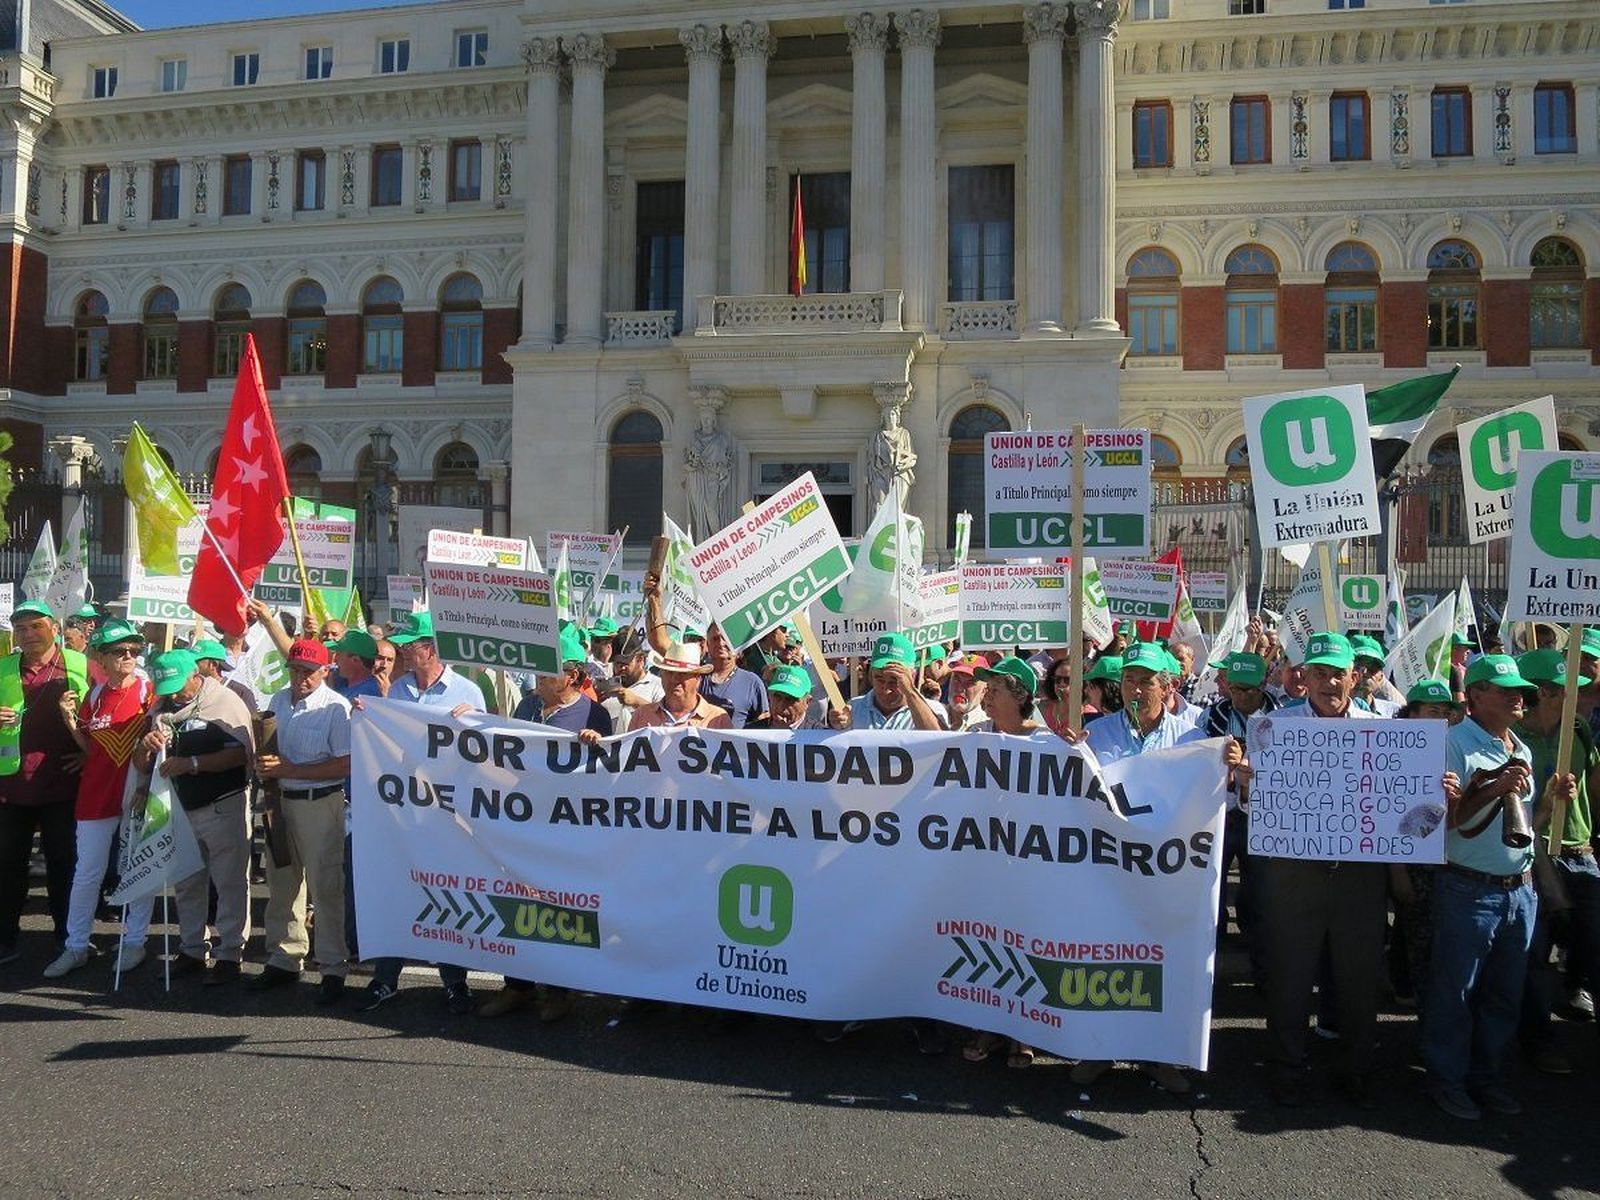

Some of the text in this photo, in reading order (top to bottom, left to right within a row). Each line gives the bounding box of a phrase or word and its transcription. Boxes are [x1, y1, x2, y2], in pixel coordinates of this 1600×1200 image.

[991, 434, 1144, 449] UNION DE CAPESINOS
[991, 453, 1059, 472] Castilla y León
[1105, 452, 1139, 465] UCCL
[995, 490, 1001, 499] a
[1002, 485, 1029, 500] Título
[1082, 488, 1100, 498] omo
[1101, 484, 1138, 501] siempre
[1273, 498, 1299, 517] La
[1475, 501, 1495, 517] La
[306, 523, 352, 533] CAMPESINOS
[691, 481, 814, 568] UNION DE CAMPESINOS
[1274, 514, 1369, 541] Extremadura
[432, 531, 524, 552] UNION DE CAMPESINOS
[580, 535, 613, 543] CAMPESIN
[699, 541, 758, 585] Castilla y León
[717, 526, 827, 608] a Título Principal, como siempre
[963, 566, 1065, 577] UNION DE CAMPESINOS
[1103, 561, 1124, 570] UNION
[1134, 563, 1175, 574] CAMPESINOS
[278, 567, 333, 585] UCCL
[430, 568, 464, 581] UNION
[466, 571, 481, 582] DE
[483, 573, 551, 591] CAMPESINOS
[928, 575, 960, 588] CAMPESIN
[963, 579, 987, 590] Castilla
[987, 582, 992, 592] y
[1529, 567, 1600, 590] La Un
[260, 586, 292, 600] UCCL
[432, 582, 486, 600] Castilla y León
[745, 567, 829, 631] UCCL
[146, 600, 195, 619] UCC
[1110, 600, 1157, 616] UCCL
[1196, 599, 1220, 609] UCCL
[438, 613, 443, 621] a
[521, 619, 549, 635] siempre
[822, 620, 839, 635] La
[980, 622, 1049, 643] UCCL
[457, 637, 537, 668] UCCL
[821, 637, 877, 654] Extremad
[427, 724, 1153, 819] POR UNA SANIDAD ANIMAL
[1260, 750, 1402, 772] MATADEROS
[1255, 770, 1434, 795] FAUNA SALVAJE
[377, 773, 1215, 876] QUE NO ARRUINE A LOS GANADEROS
[1251, 811, 1376, 835] POLITICOS
[1249, 834, 1415, 857] COMUNIDADES
[410, 869, 600, 910] UNION DE CAMPESINOS
[513, 904, 593, 944] UCCL
[411, 923, 516, 956] Castilla y León
[936, 920, 1164, 961] UNION DE CAMPESINOS
[717, 944, 788, 975] Unión
[695, 973, 808, 1005] de Uniones
[1059, 967, 1151, 1007] UCCL
[936, 980, 1062, 1028] Castilla y León
